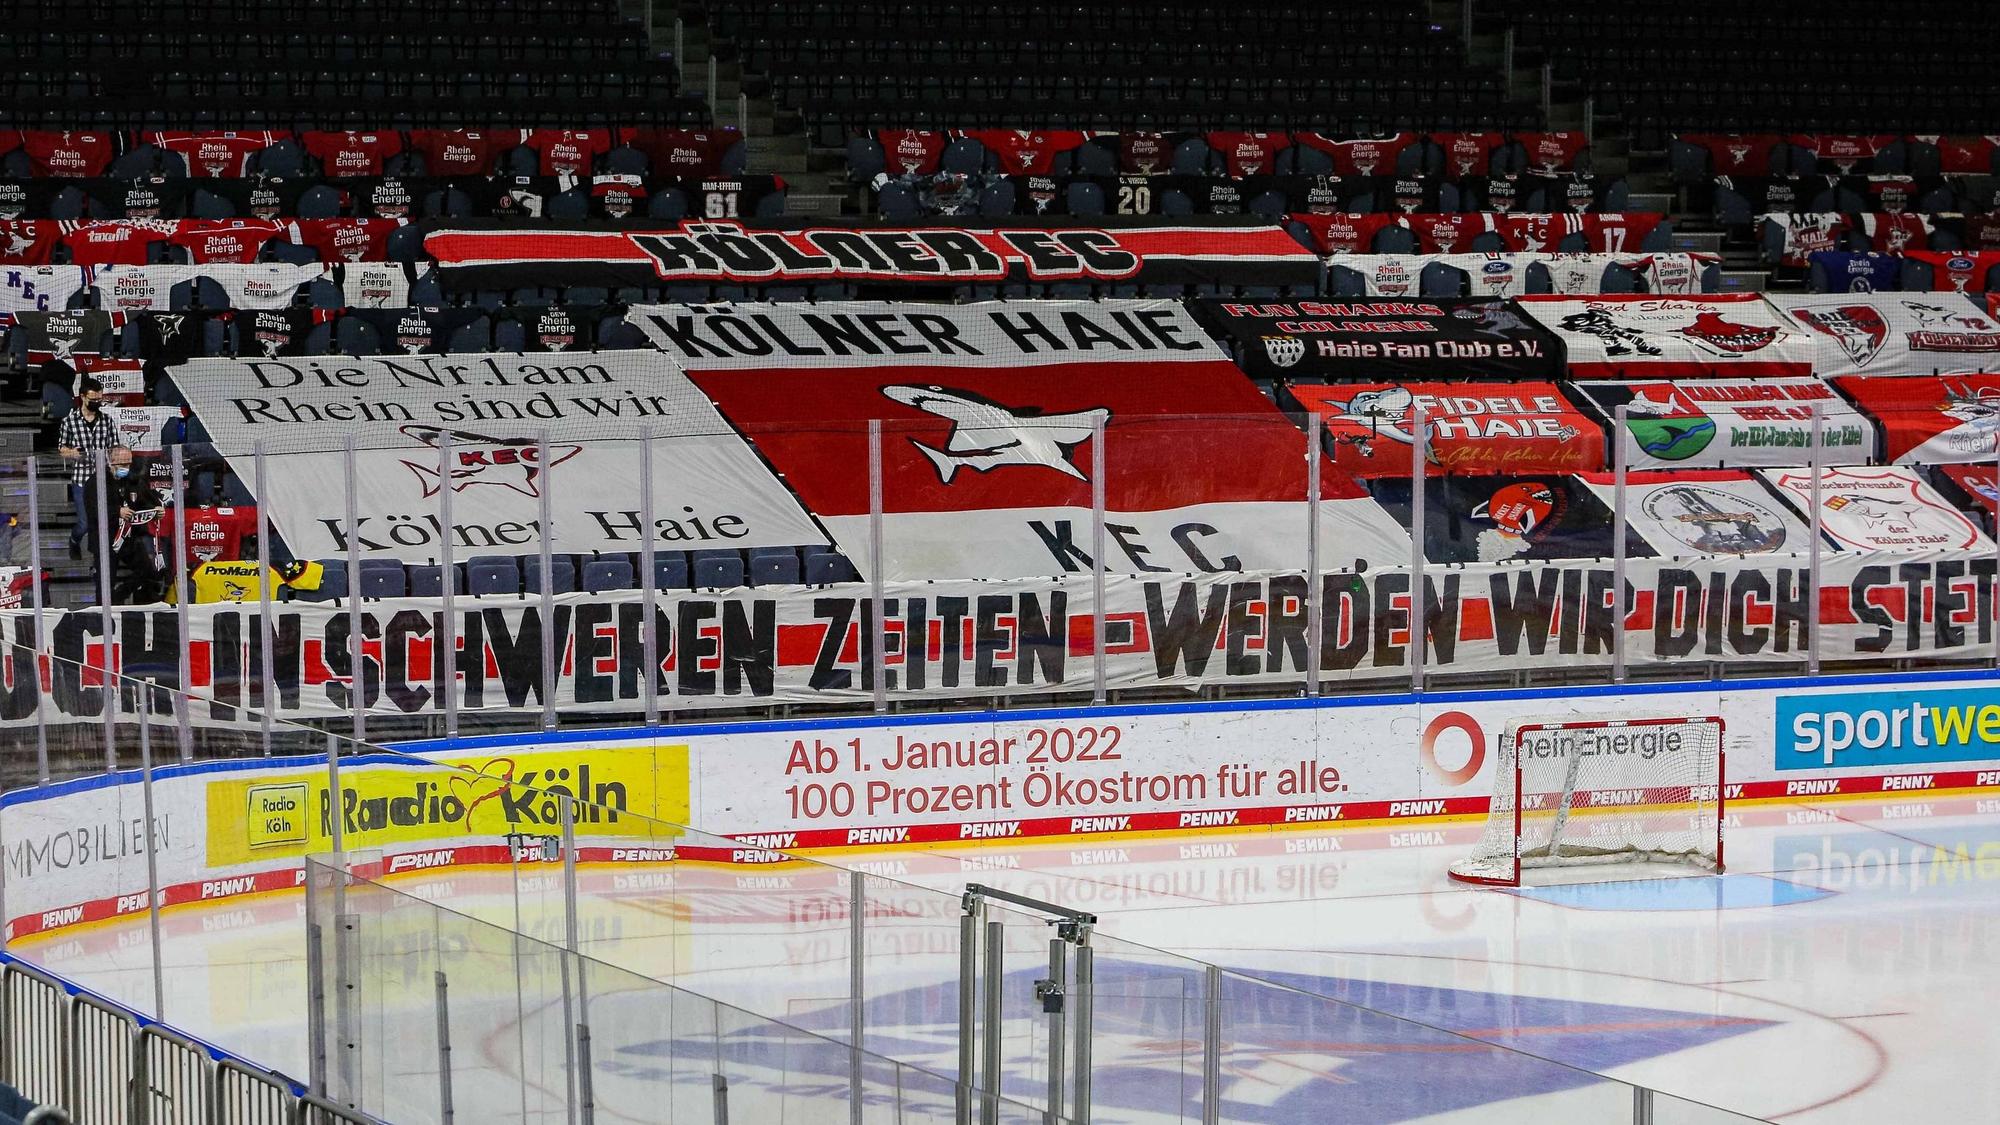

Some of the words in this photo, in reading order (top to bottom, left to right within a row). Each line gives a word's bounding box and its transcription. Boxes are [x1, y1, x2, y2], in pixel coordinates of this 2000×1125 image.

[201, 143, 228, 153] Rhein
[554, 144, 578, 154] Rhein
[900, 139, 923, 149] Rhein
[53, 150, 81, 160] Rhein
[340, 150, 365, 160] Rhein
[446, 145, 472, 156] Rhein
[199, 151, 234, 162] Energie
[50, 158, 87, 169] Energie
[336, 158, 372, 169] Energie
[129, 191, 155, 201] Rhein
[252, 190, 276, 199] Rhein
[375, 187, 405, 197] Rhein
[608, 190, 629, 199] Rhein
[1212, 187, 1236, 196] Rhein
[125, 198, 160, 209] Energie
[372, 194, 411, 205] Energie
[1117, 187, 1150, 215] 20
[705, 193, 739, 218] 61
[336, 229, 364, 240] Rhein
[206, 237, 237, 248] Rhein
[333, 236, 371, 248] Energie
[1603, 228, 1626, 253] 17
[204, 245, 244, 255] Energie
[629, 220, 1005, 279] KÖLNER
[996, 228, 1142, 279] EC
[363, 272, 388, 280] Rhein
[1378, 266, 1404, 275] Rhein
[118, 278, 149, 288] Rhein
[361, 278, 393, 289] Energie
[1375, 273, 1411, 284] Energie
[247, 281, 272, 290] Rhein
[114, 286, 156, 299] Energie
[243, 288, 278, 298] Energie
[1220, 303, 1299, 318] FUN
[1299, 301, 1446, 317] SHARKS
[49, 317, 78, 327] Rhein
[258, 312, 286, 323] Rhein
[401, 318, 427, 328] Rhein
[540, 316, 571, 327] Rhein
[46, 325, 84, 336] Energie
[255, 320, 292, 332] Energie
[396, 325, 433, 336] Energie
[537, 324, 577, 336] Energie
[646, 305, 986, 358] KÖLNER
[987, 310, 1206, 352] HAIE
[1275, 319, 1439, 334] COLOGNE
[1316, 340, 1378, 358] Haie
[1380, 341, 1431, 359] Fan
[1436, 340, 1492, 358] Club
[245, 362, 370, 389] Die
[227, 396, 417, 425] Rhein
[433, 392, 569, 423] sind
[569, 389, 673, 418] wir
[1413, 395, 1563, 415] FIDELE
[1433, 416, 1562, 440] HAIE
[458, 447, 539, 466] KEC
[192, 522, 220, 533] Rhein
[317, 513, 556, 553] Kölner
[584, 505, 751, 547] Haie
[1888, 525, 1910, 535] der
[190, 530, 226, 542] Energie
[325, 598, 776, 710] SCHWEREN
[810, 590, 1068, 691] ZEITEN
[1144, 571, 1461, 679] WERDEN
[1489, 567, 1635, 657] WIR
[1654, 567, 1811, 656] DICH
[785, 739, 837, 776] Ab
[847, 737, 872, 773] 1.
[881, 733, 1017, 771] Januar
[1025, 725, 1122, 764] 2022
[785, 782, 855, 820] 100
[866, 776, 1012, 817] Prozent
[1022, 764, 1206, 810] Ökostrom
[1216, 763, 1269, 800] für
[1276, 759, 1350, 797] alle.
[262, 796, 296, 813] Radio
[266, 817, 292, 834] Köln
